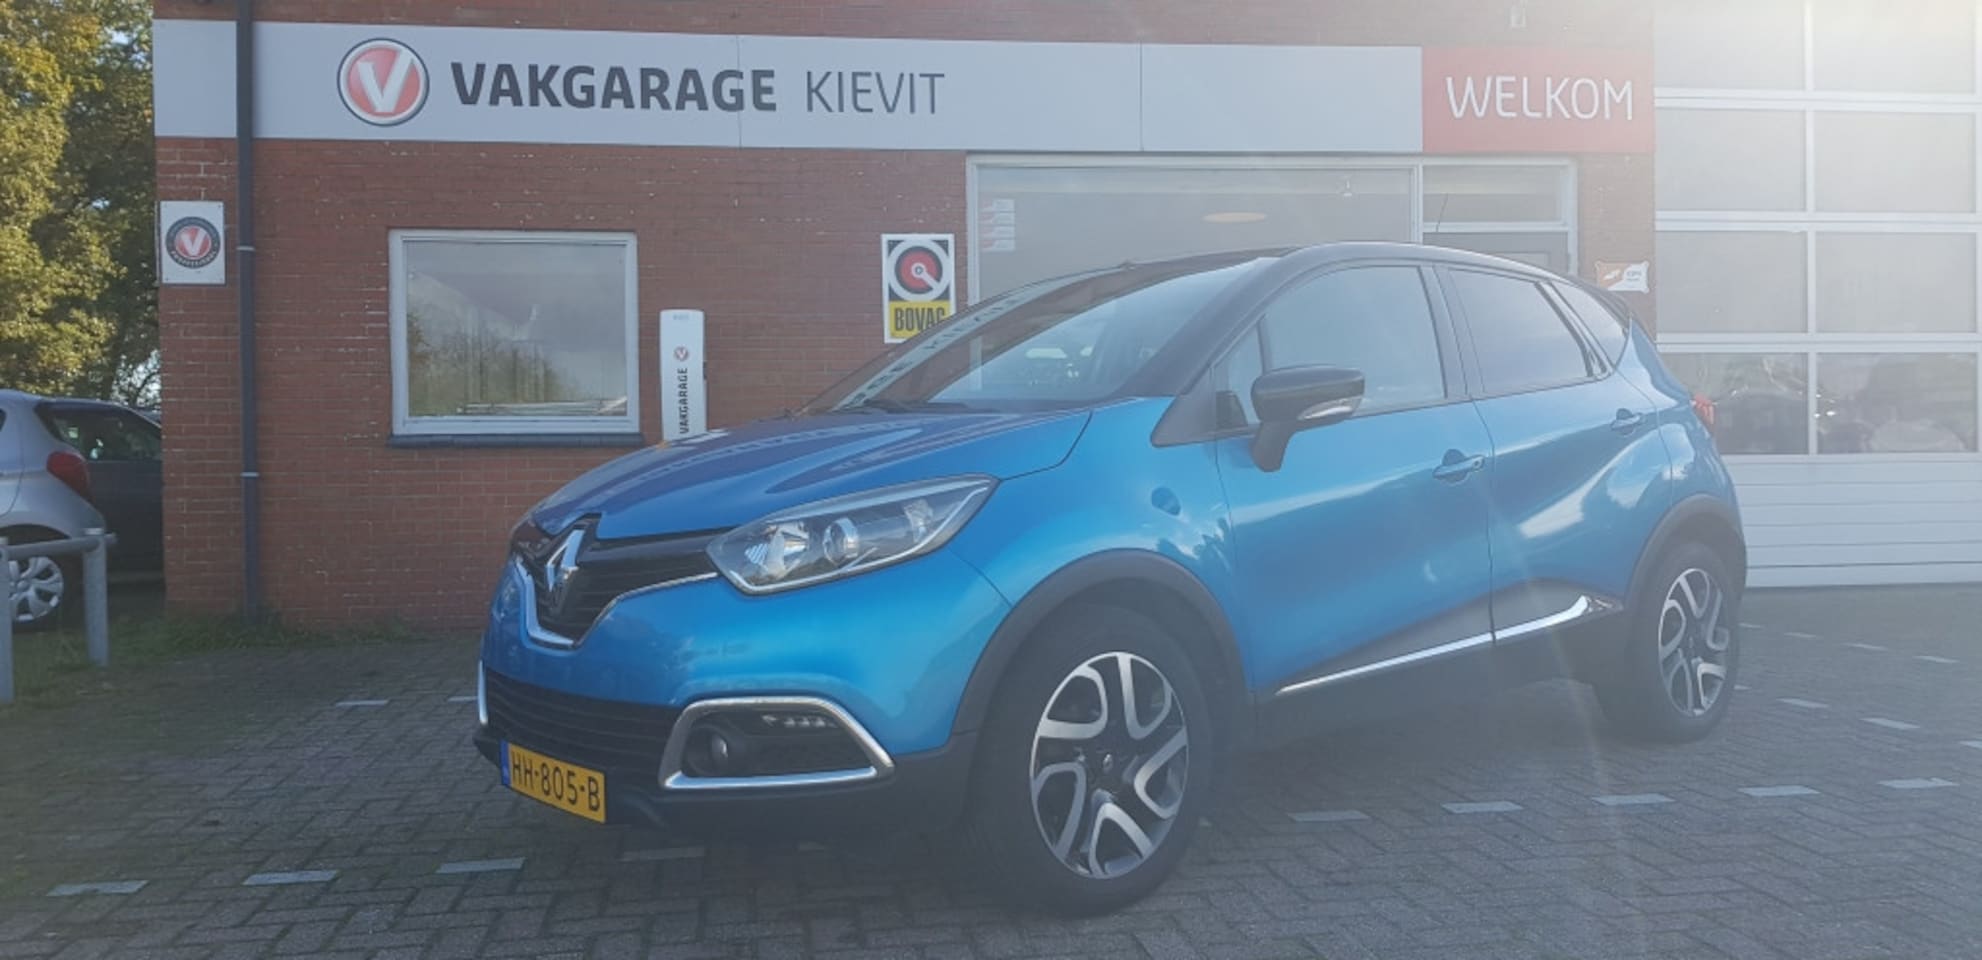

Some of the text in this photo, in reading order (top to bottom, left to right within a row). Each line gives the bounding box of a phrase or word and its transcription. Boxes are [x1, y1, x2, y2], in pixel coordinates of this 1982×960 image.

[356, 48, 945, 115] V VAKGARAGE KIEVIT
[1446, 75, 1633, 121] WELKOM
[677, 366, 690, 435] VAKGARAGE
[511, 750, 600, 812] HH-805-B
